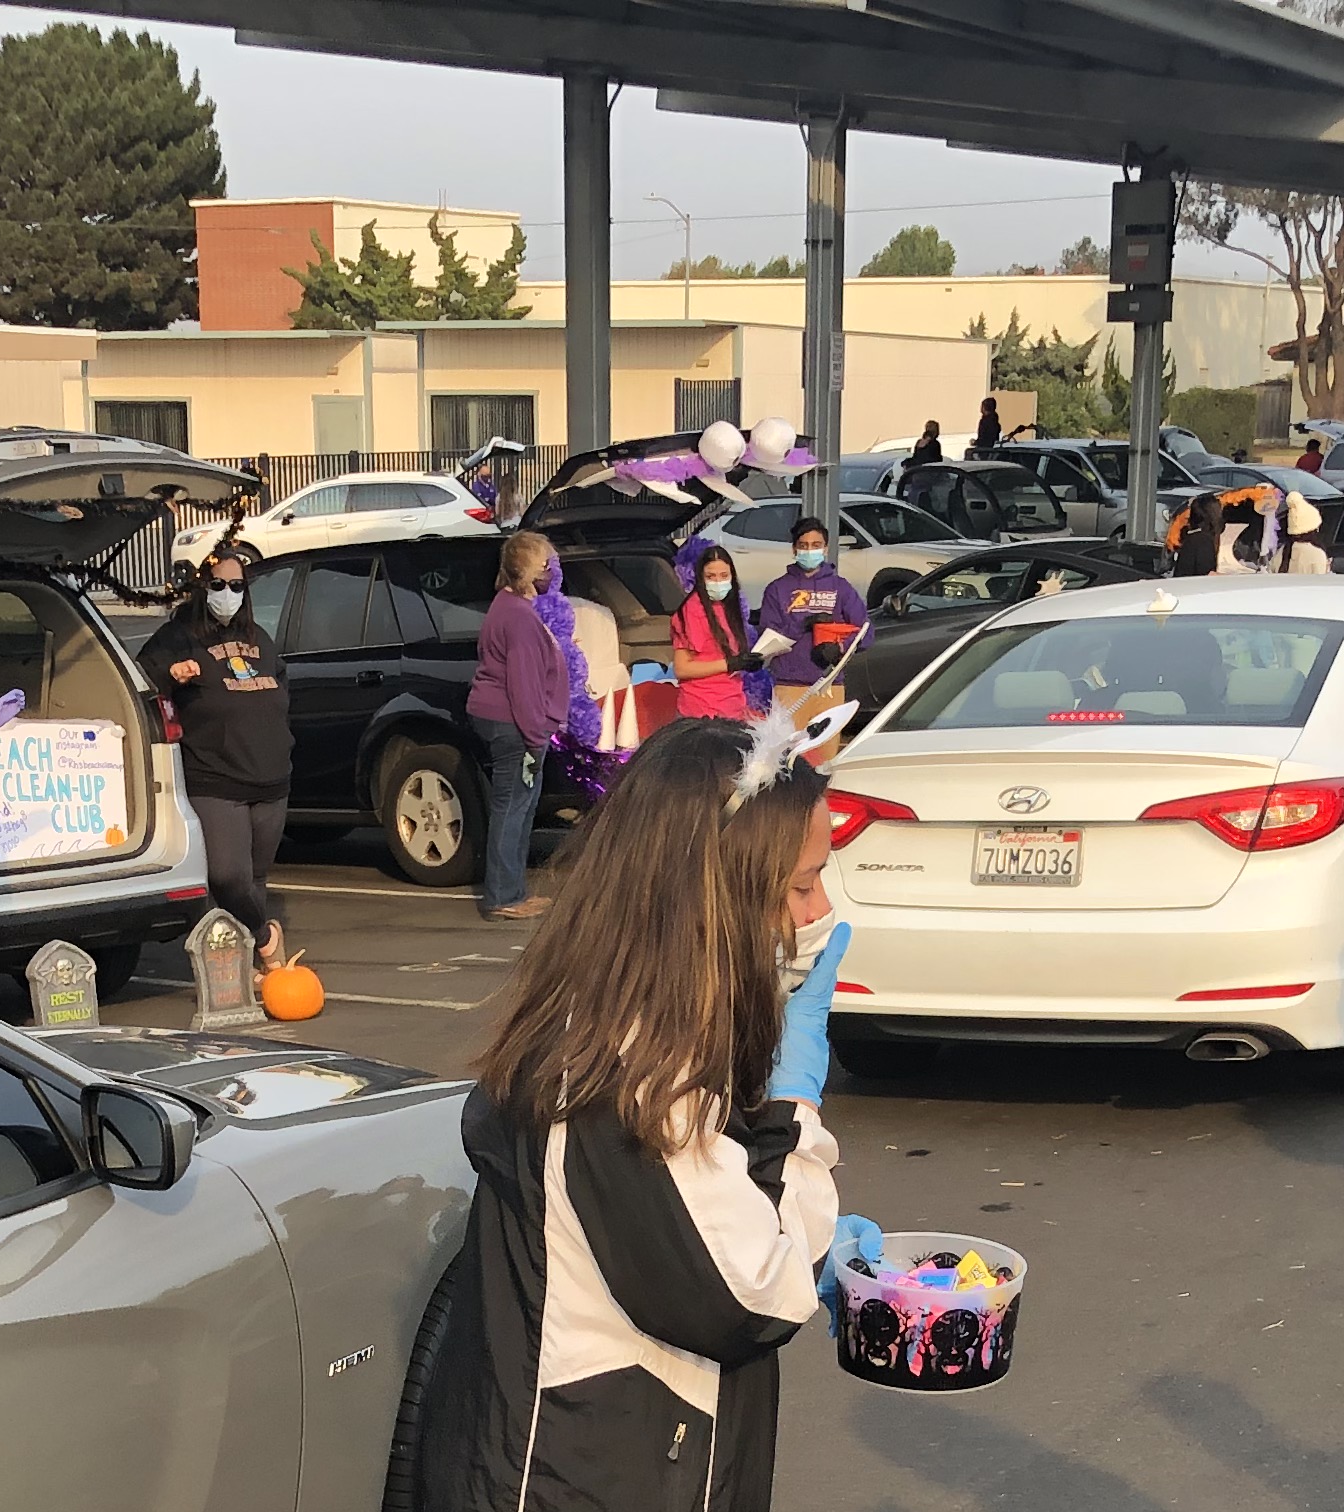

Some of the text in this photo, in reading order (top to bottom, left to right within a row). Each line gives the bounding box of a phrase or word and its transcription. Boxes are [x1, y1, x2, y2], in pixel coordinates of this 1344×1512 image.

[59, 728, 78, 739] Our
[2, 772, 106, 803] CLEAN-UP
[51, 804, 105, 834] CLUB
[855, 863, 925, 872] SONATA
[983, 848, 1074, 874] 7UMZ036
[50, 990, 85, 1006] REST
[47, 1007, 92, 1024] ETERNALLY
